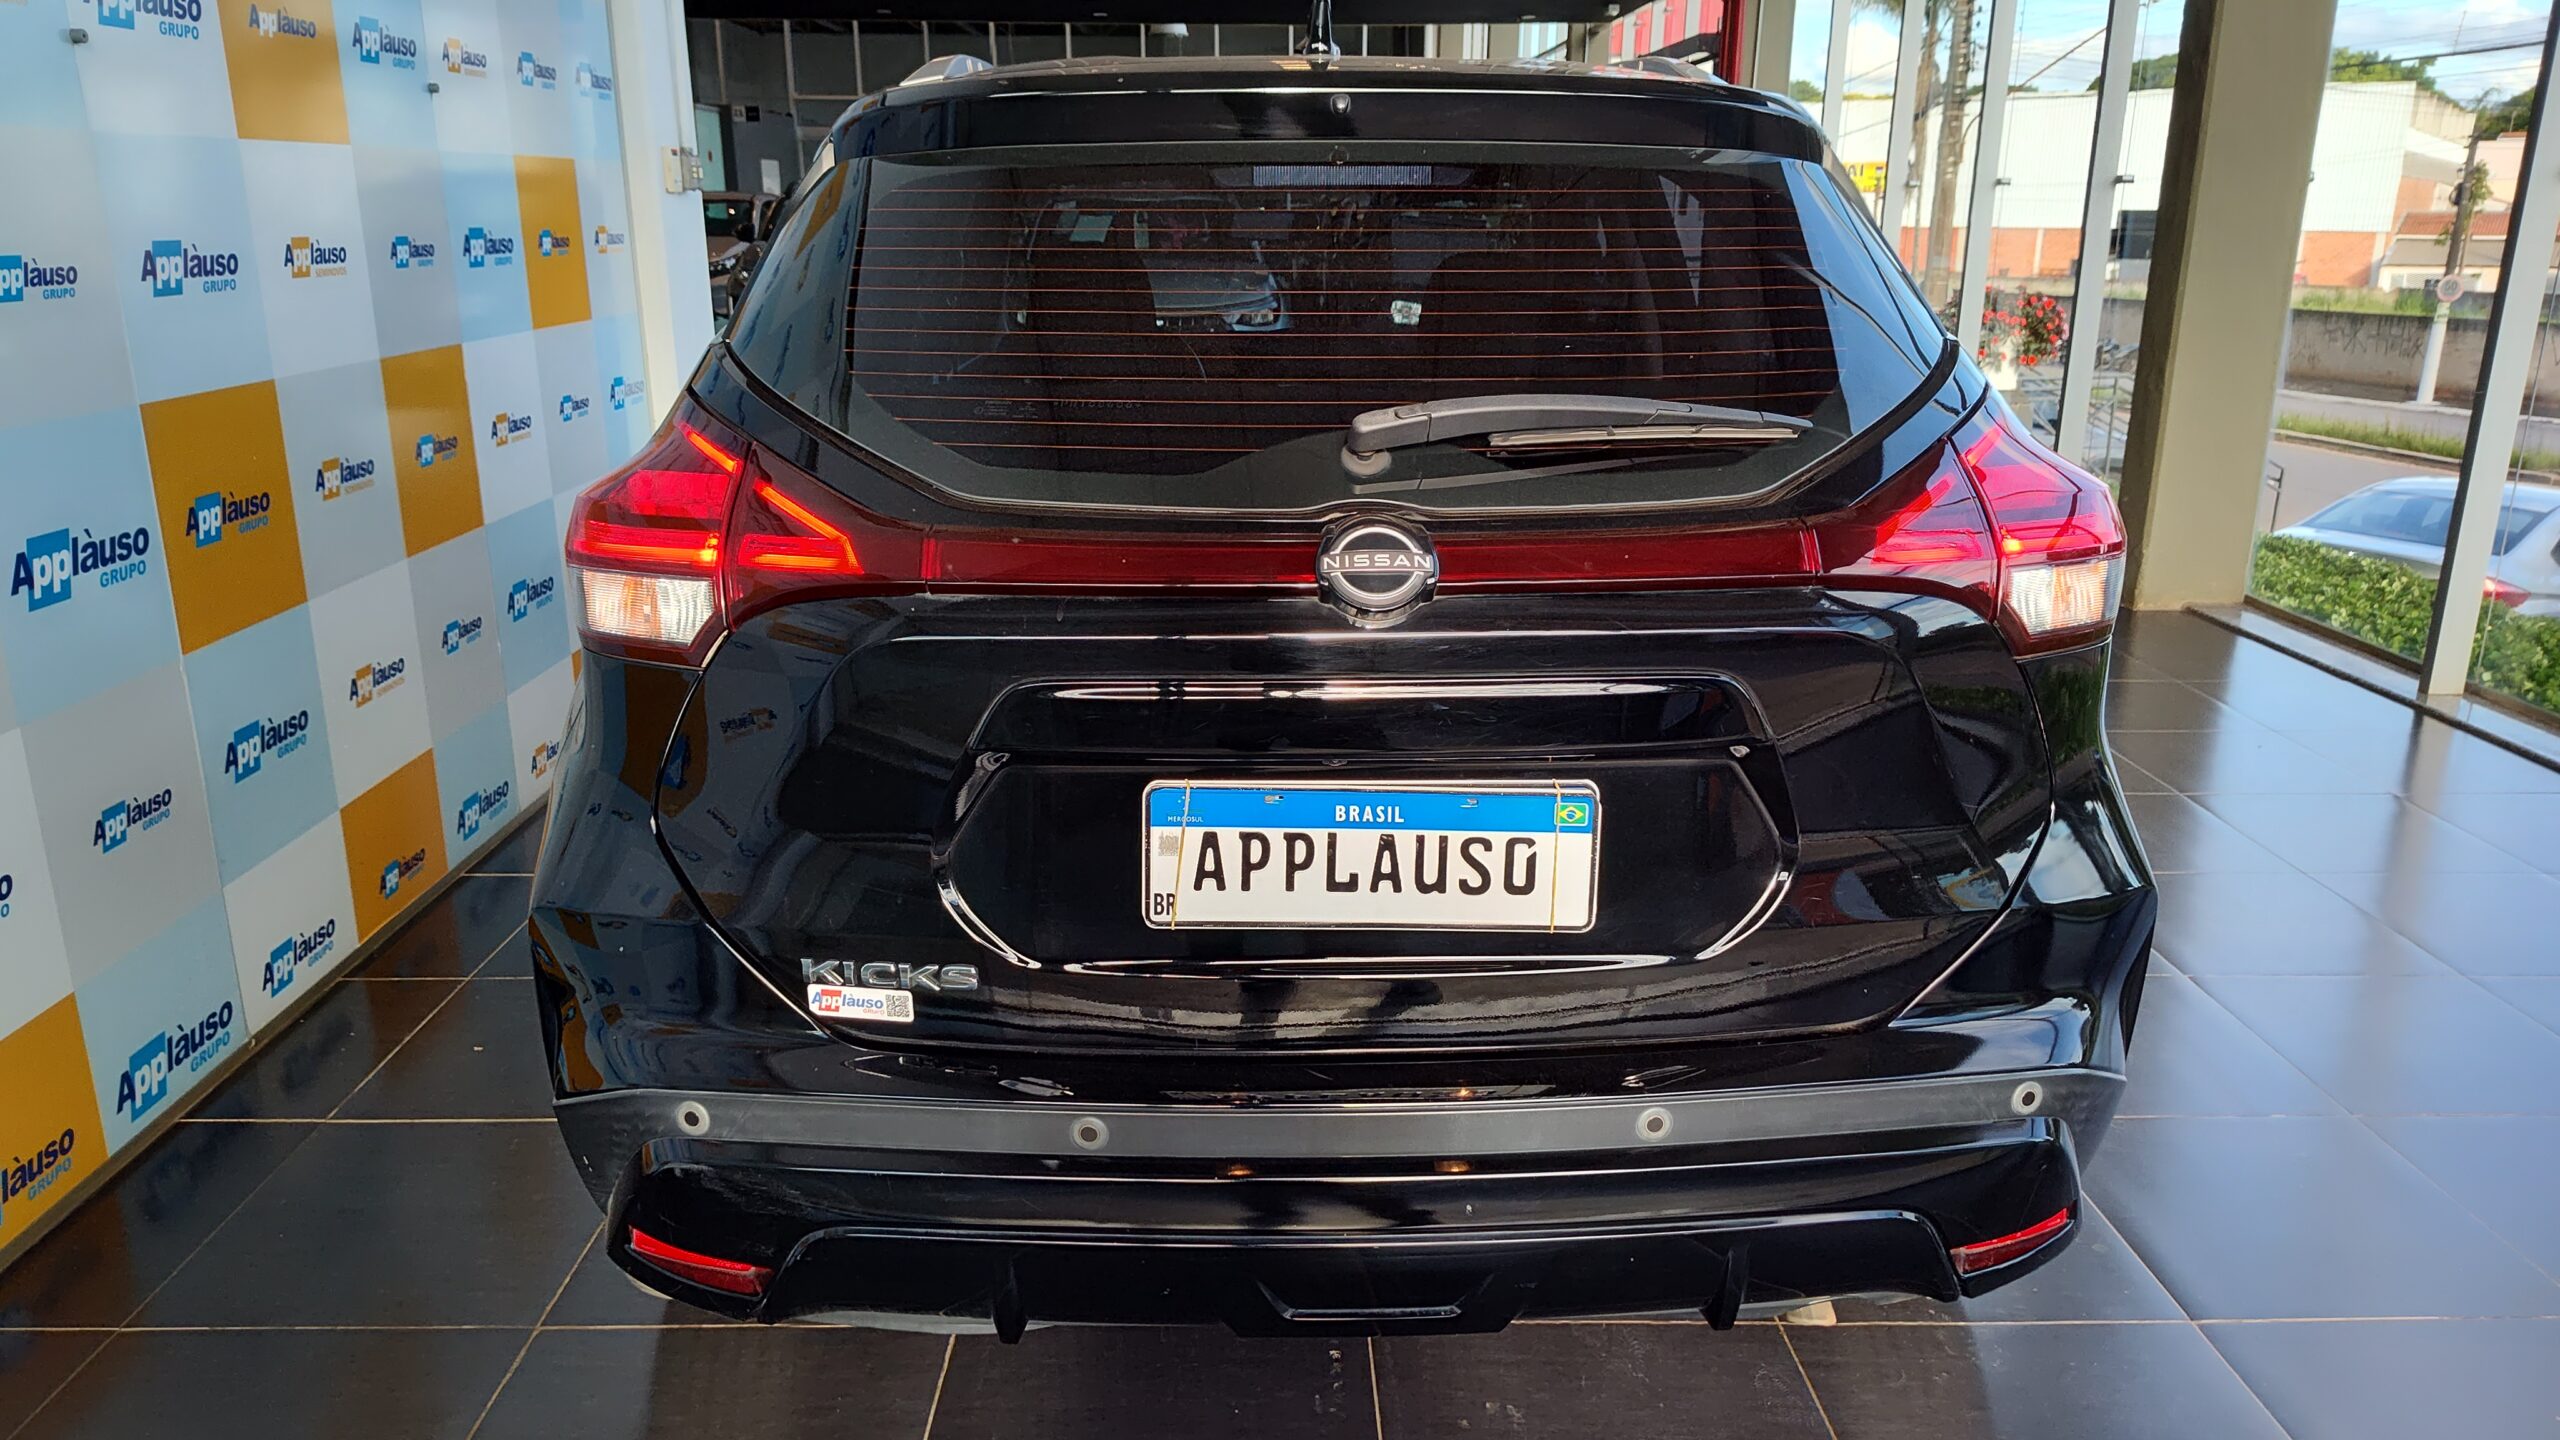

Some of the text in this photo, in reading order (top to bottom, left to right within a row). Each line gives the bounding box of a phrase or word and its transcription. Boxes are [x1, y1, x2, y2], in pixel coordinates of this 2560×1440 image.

[159, 20, 199, 40] GRUPO
[352, 22, 417, 58] Applàuso
[141, 244, 239, 289] Applàuso
[284, 239, 347, 273] Applàuso
[43, 287, 75, 300] GRUPO
[203, 278, 237, 293] GRUPO
[186, 491, 271, 539] Applàuso
[11, 526, 150, 600] Applàuso
[100, 559, 147, 588] GRUPO
[1322, 553, 1432, 570] NISSAN
[224, 710, 309, 775] Applàuso
[277, 733, 307, 759] GRUPO
[93, 788, 172, 847] Applàuso
[142, 808, 171, 831] GRUPO
[1335, 804, 1405, 823] BRASIL
[1193, 831, 1537, 896] APPLAUSO
[1153, 892, 1177, 916] BR
[262, 918, 335, 992] Applàuso
[800, 957, 979, 992] KICKS
[811, 991, 884, 1009] Applàuso
[116, 1000, 233, 1116] Applàuso
[190, 1030, 231, 1073] GRUPO
[28, 1157, 72, 1201] GRUPO
